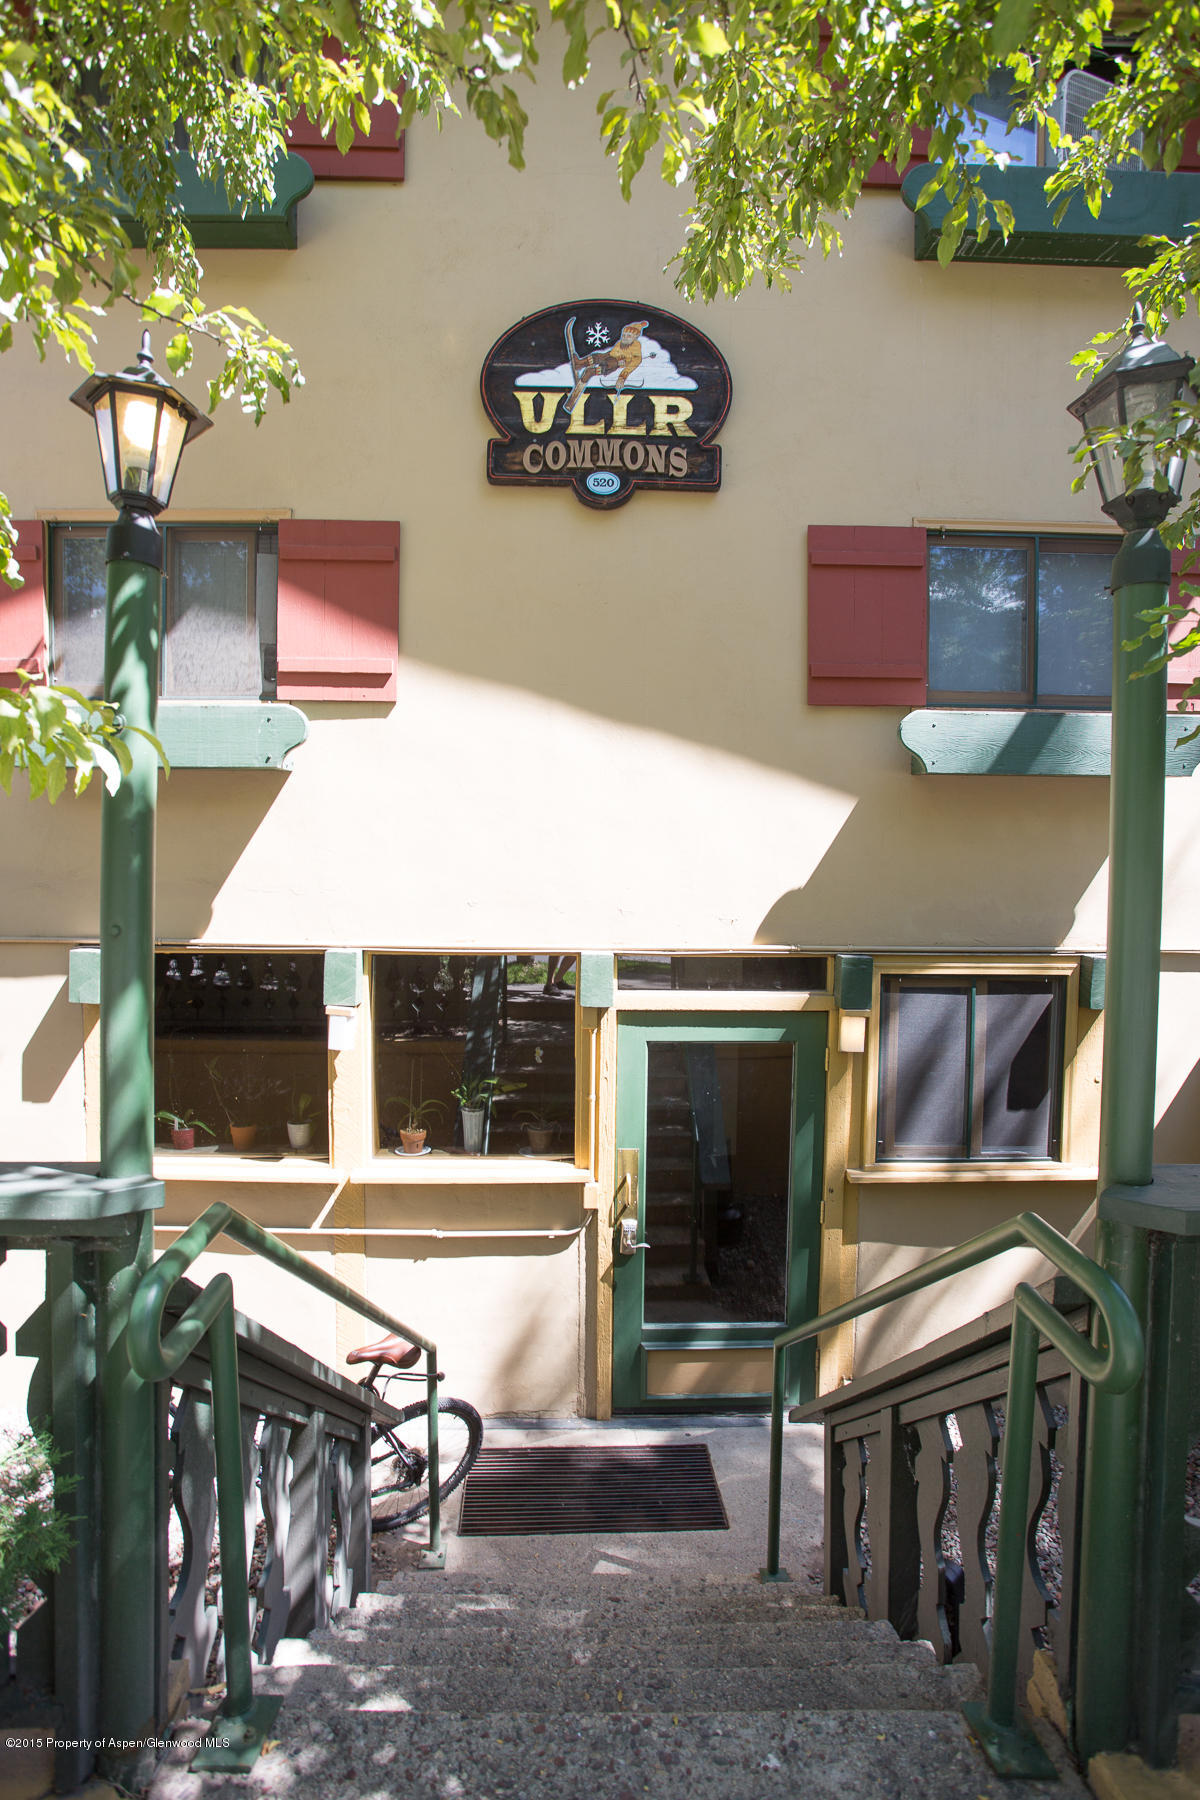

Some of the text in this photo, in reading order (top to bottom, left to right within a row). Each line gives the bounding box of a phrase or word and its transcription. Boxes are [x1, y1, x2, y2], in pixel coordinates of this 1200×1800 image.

[512, 391, 698, 437] ULLR
[522, 438, 688, 478] COMMONS
[592, 477, 615, 488] 520
